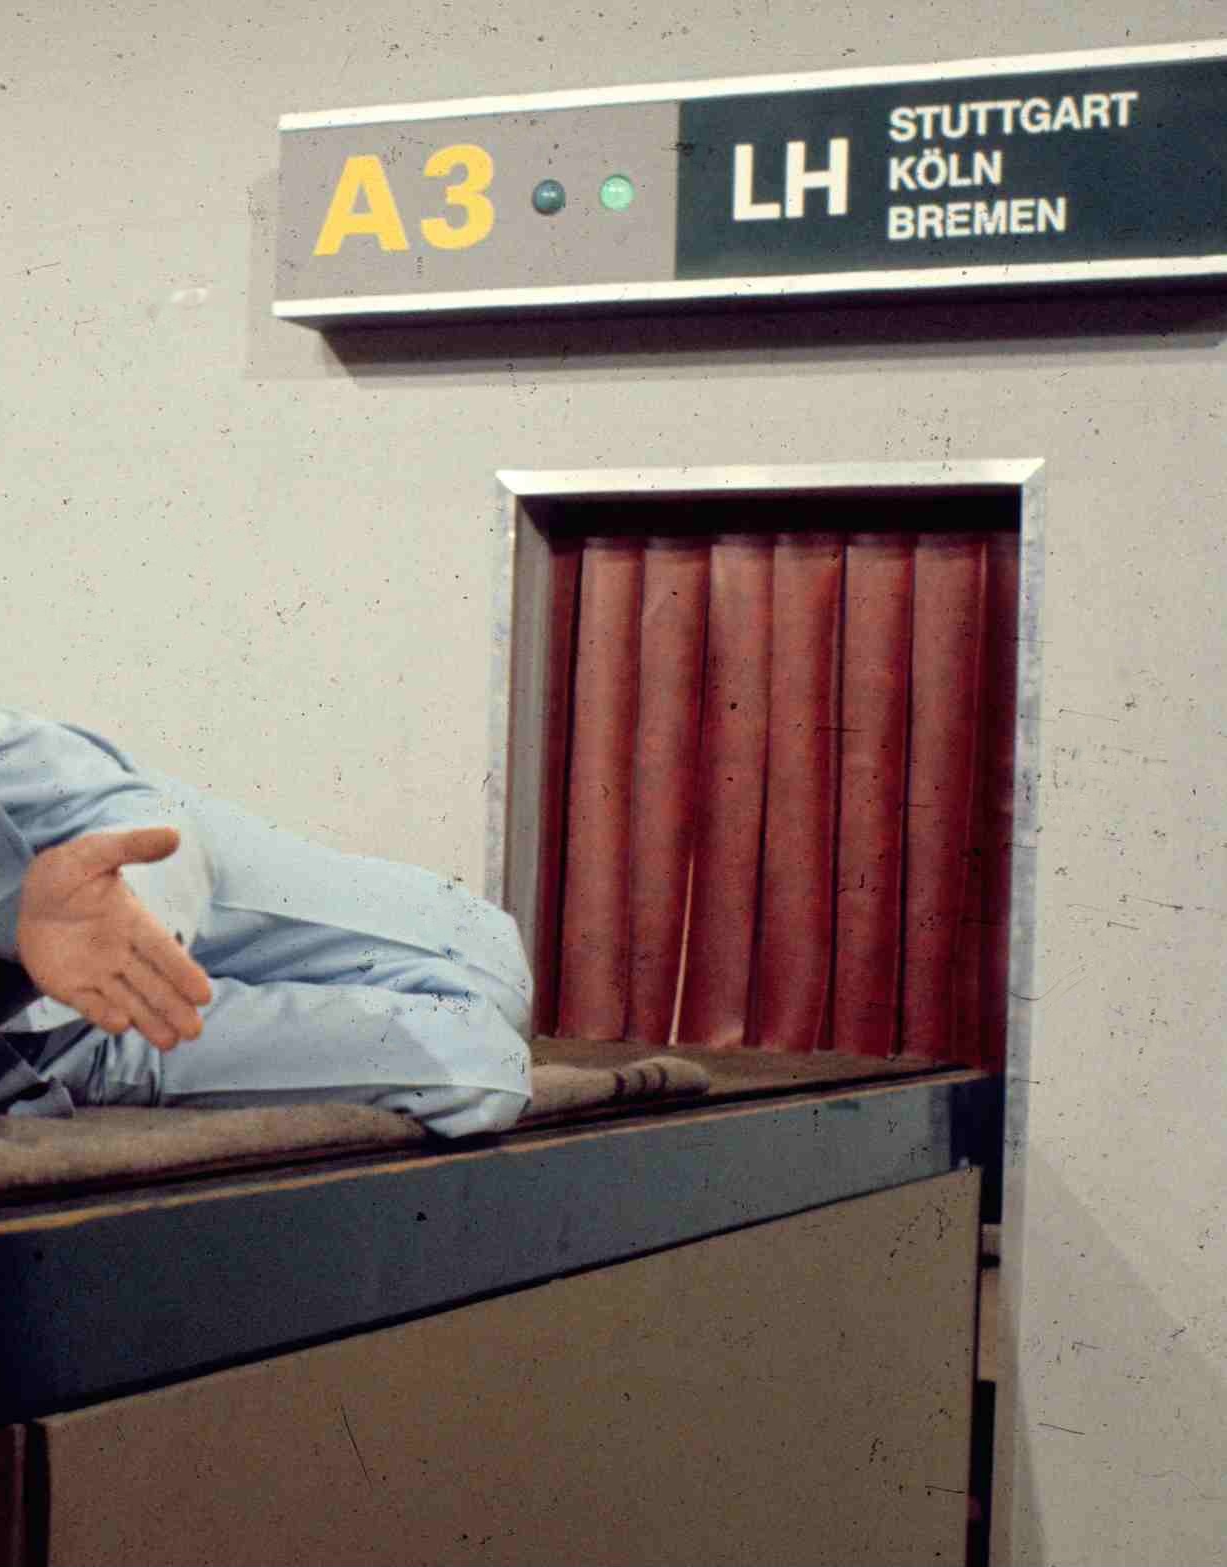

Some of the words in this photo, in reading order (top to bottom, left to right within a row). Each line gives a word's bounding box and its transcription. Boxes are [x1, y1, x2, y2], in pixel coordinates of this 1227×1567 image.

[887, 90, 1139, 143] STUTTGART
[732, 137, 850, 222] LH
[887, 148, 1003, 192] KÖLN
[312, 144, 495, 257] A3
[887, 196, 1067, 241] BREMEN
